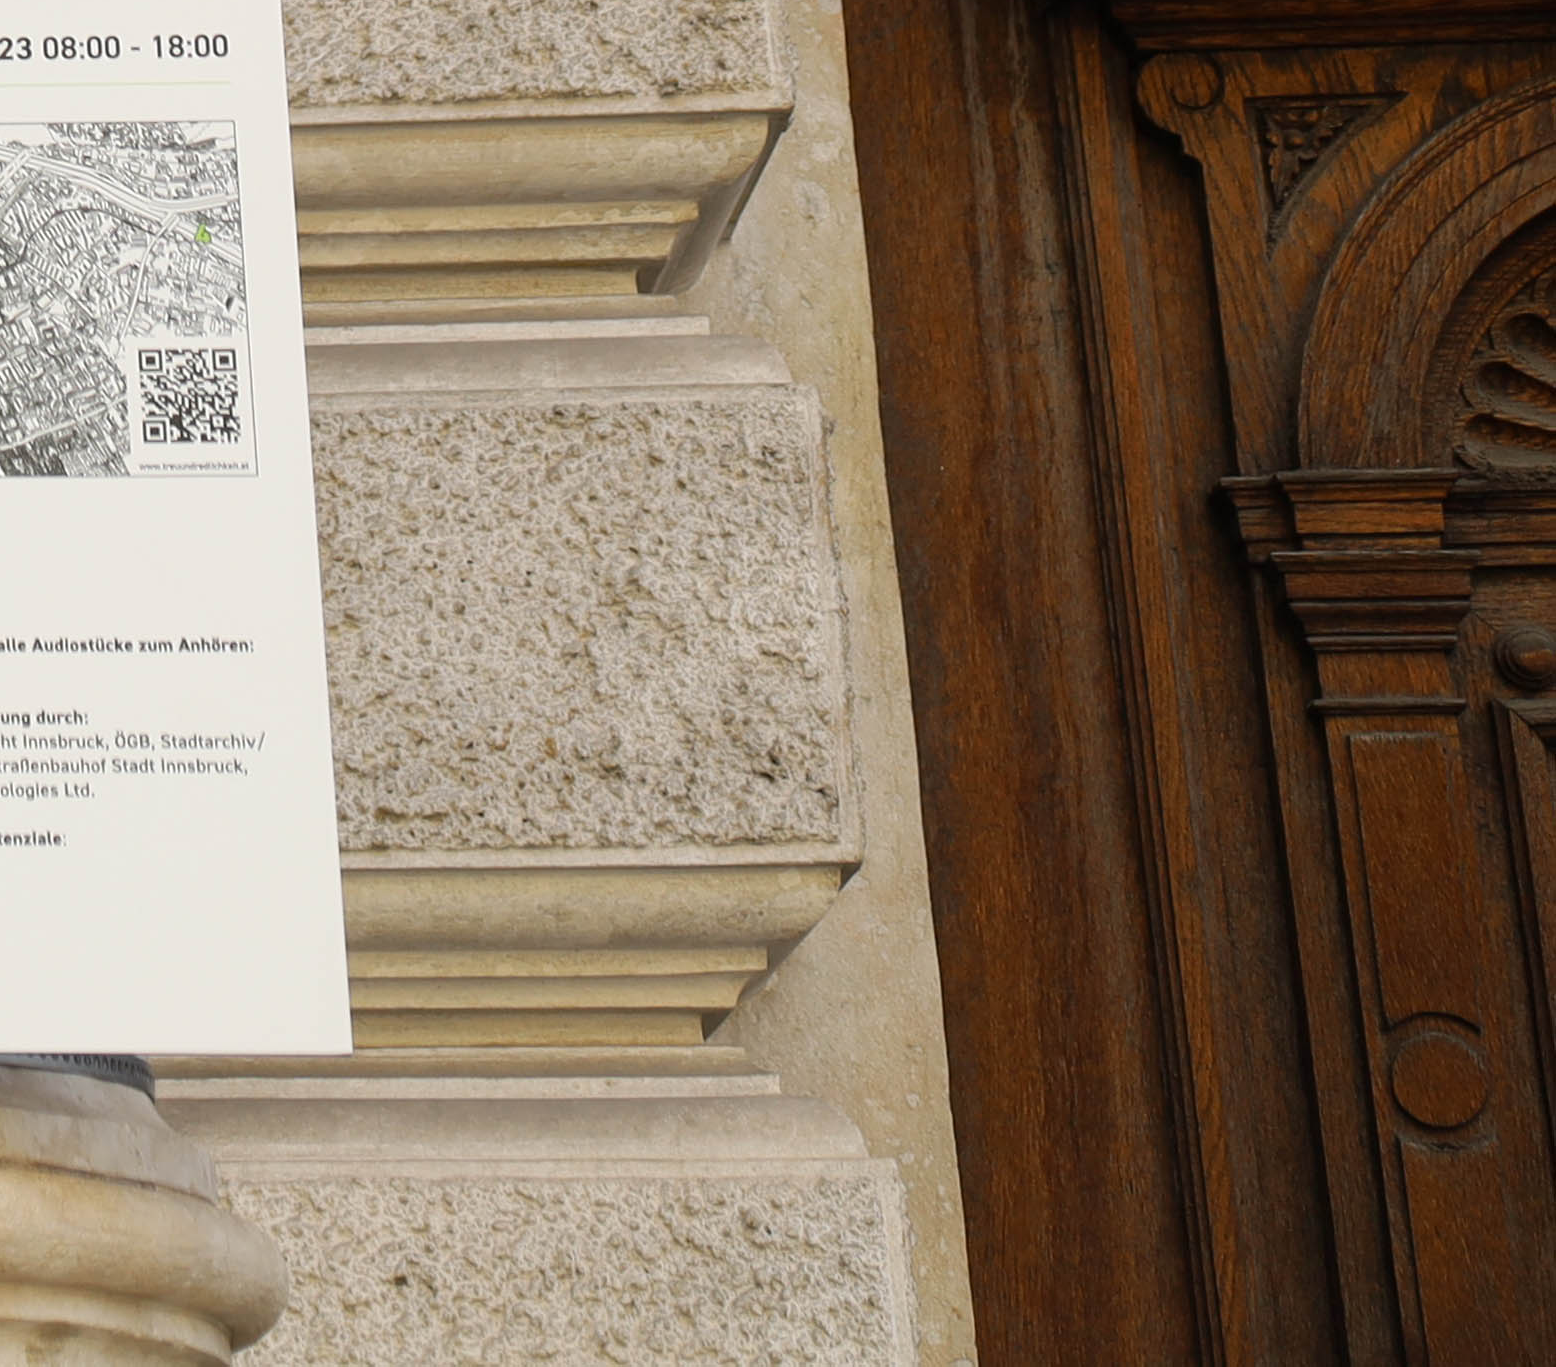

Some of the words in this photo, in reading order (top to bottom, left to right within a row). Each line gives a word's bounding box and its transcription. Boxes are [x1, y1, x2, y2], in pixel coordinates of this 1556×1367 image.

[42, 34, 121, 60] 08:00
[152, 33, 229, 59] 18:00
[31, 636, 133, 653] Audiostücke
[138, 640, 173, 653] zum
[178, 636, 254, 653] Anhören:
[35, 709, 88, 725] durch:
[22, 733, 109, 751] Innsbruck,
[114, 730, 155, 751] ÖGB,
[160, 731, 265, 751] Stadtarchiv/
[111, 757, 155, 773] Stadt
[160, 757, 248, 776] Innsbruck,
[64, 782, 95, 798] Ltd.
